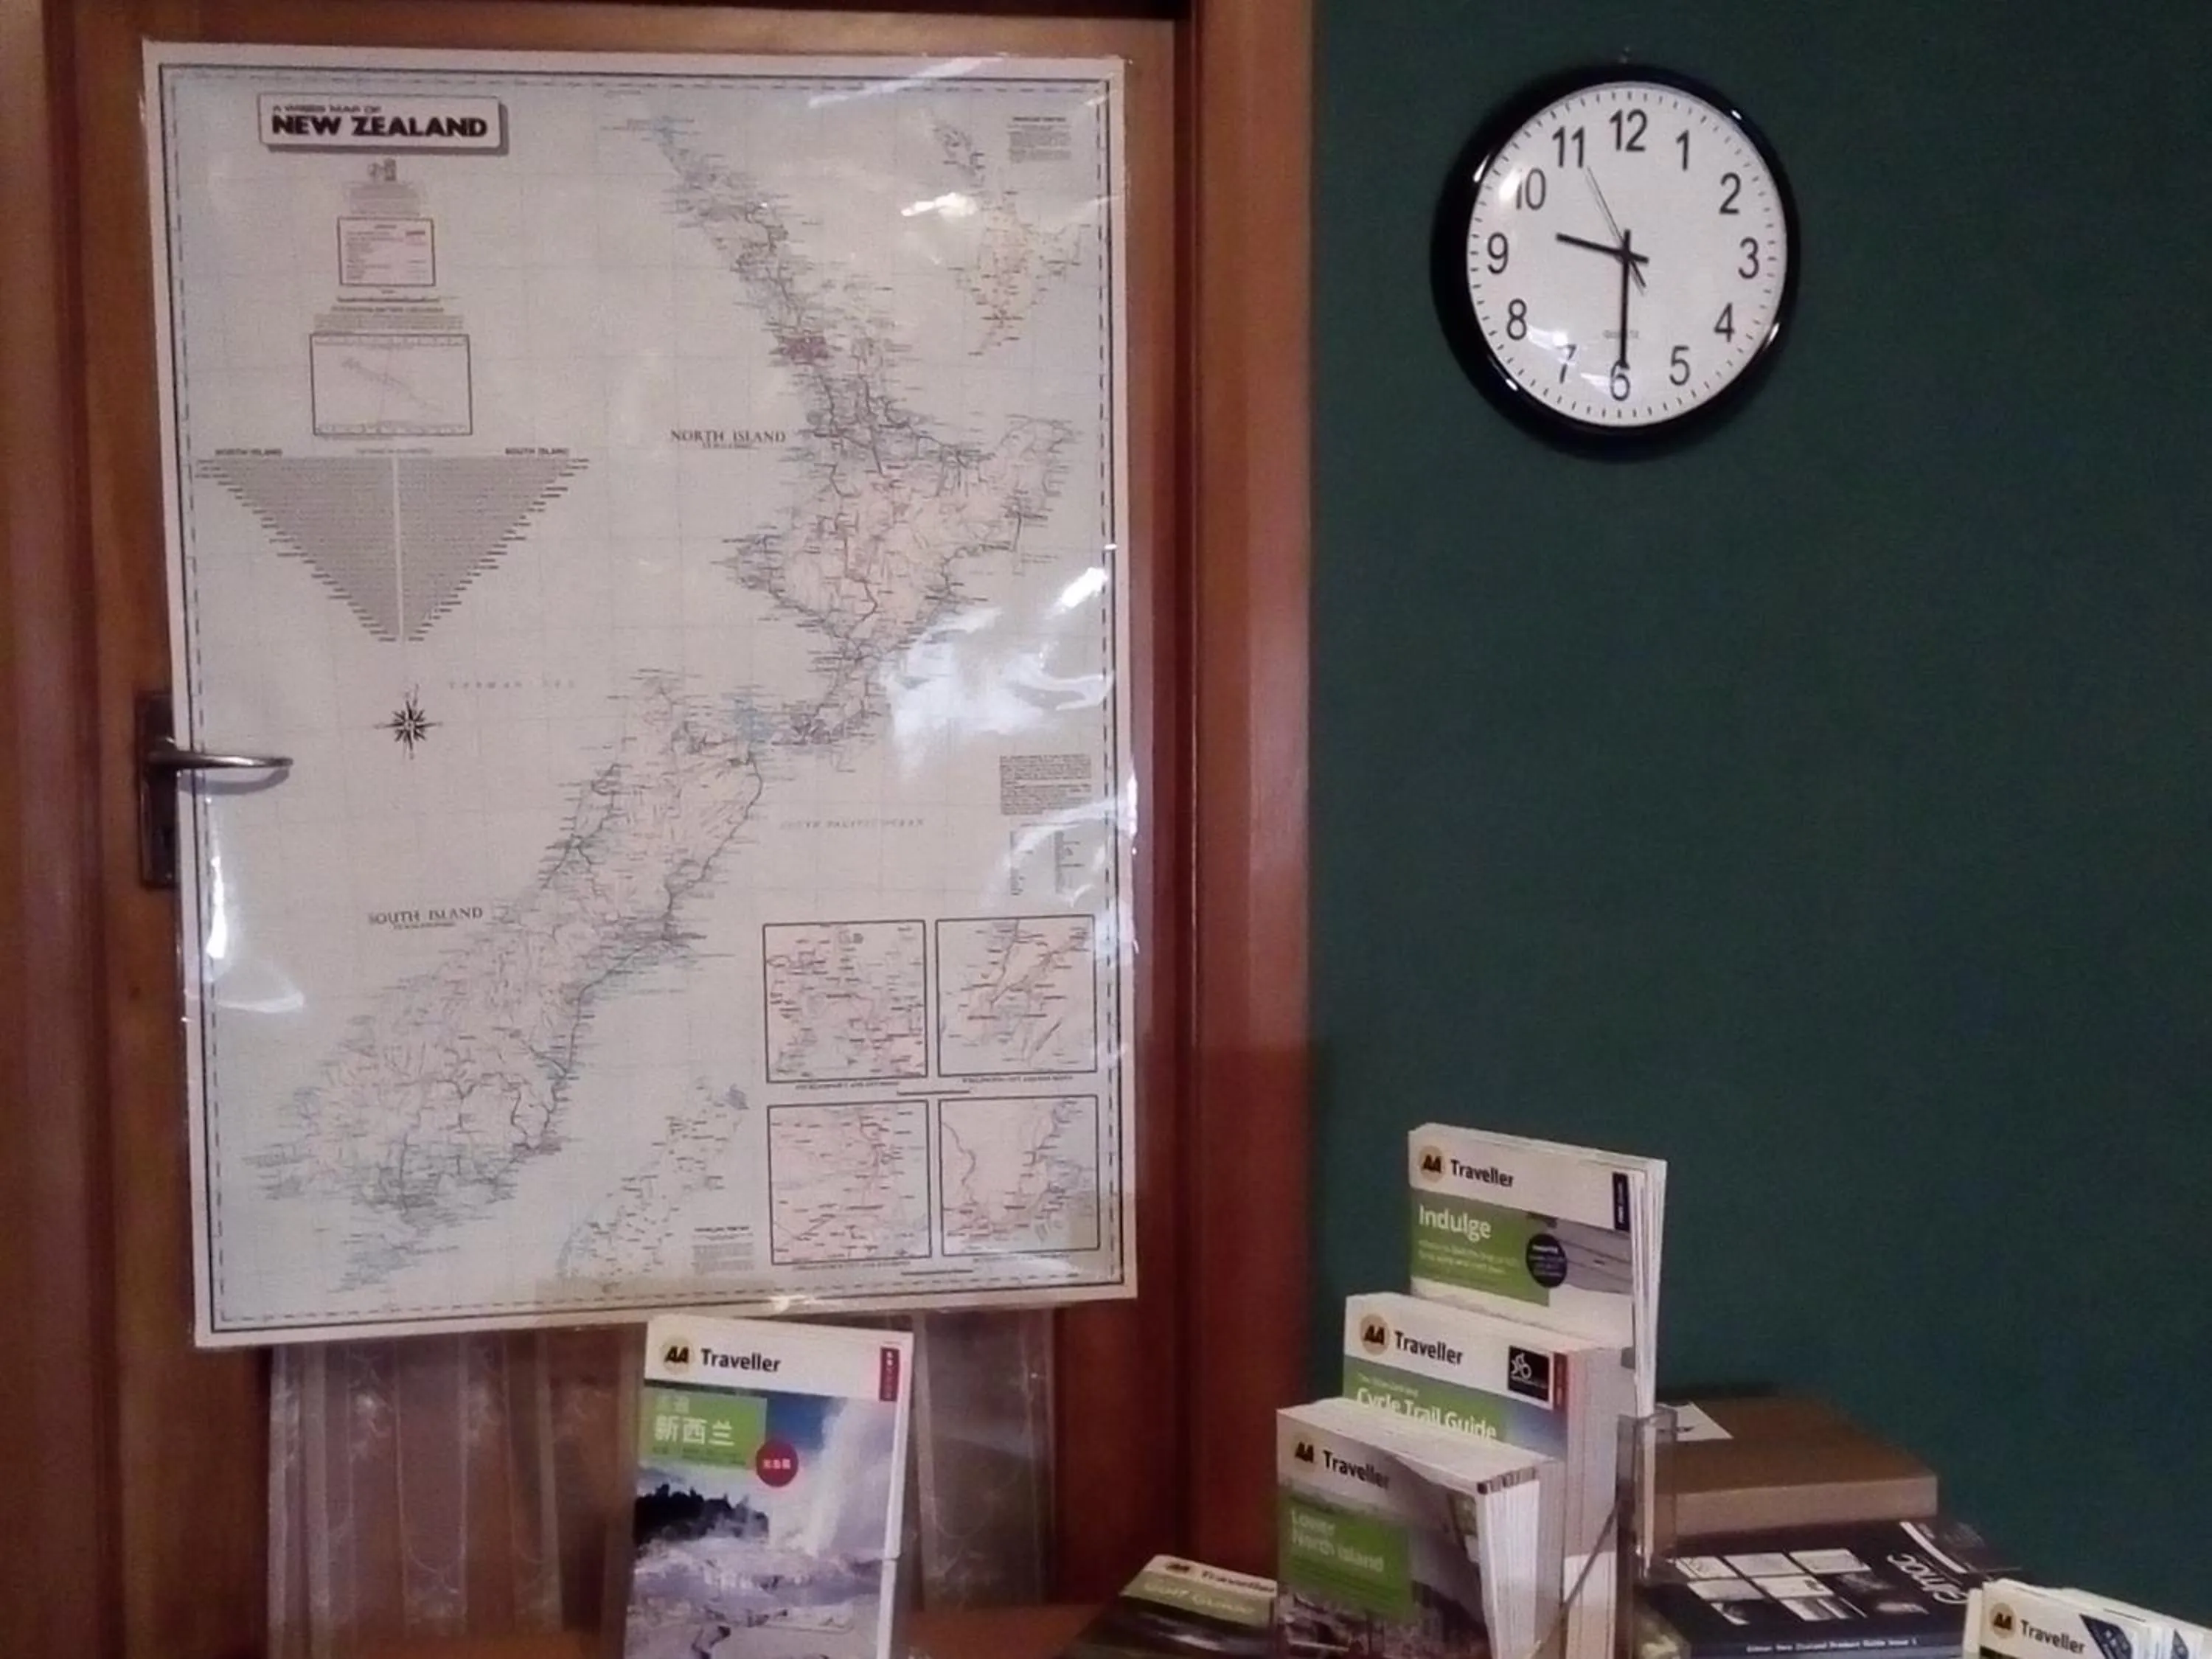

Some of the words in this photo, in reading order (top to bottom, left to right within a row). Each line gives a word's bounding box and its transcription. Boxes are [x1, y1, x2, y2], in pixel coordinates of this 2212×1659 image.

[272, 115, 341, 135] NEW
[352, 116, 487, 137] ZEALAND
[1609, 108, 1648, 152] 12
[1552, 126, 1585, 168] 11
[1676, 130, 1690, 171] 1
[1515, 168, 1546, 210] 10
[1719, 173, 1742, 215] 2
[1487, 232, 1509, 274] 9
[1738, 237, 1760, 279] 3
[1506, 299, 1527, 340] 8
[1714, 303, 1734, 342] 4
[1557, 344, 1577, 383] 7
[1610, 360, 1630, 400] 6
[1670, 346, 1690, 385] 5
[671, 429, 724, 442] NORTH
[733, 430, 786, 442] ISLAND
[369, 909, 420, 925] SOUTH
[429, 906, 483, 920] ISLAND
[1421, 1154, 1441, 1173] AA
[1450, 1158, 1514, 1187] Traveller
[1419, 1204, 1492, 1242] Indulge
[665, 1346, 689, 1363] AA
[700, 1348, 782, 1372] Traveller
[1363, 1324, 1385, 1346] AA
[1394, 1330, 1464, 1366] Traveller
[654, 1414, 735, 1447] 新西兰
[1357, 1388, 1401, 1411] Cycle
[1402, 1399, 1441, 1427] Trail
[1444, 1411, 1497, 1441] Guide
[1322, 1450, 1390, 1489] Traveller
[1292, 1509, 1335, 1536] Lower
[1292, 1533, 1335, 1556] North
[1337, 1545, 1384, 1572] Island
[1993, 1612, 2012, 1630] AA
[2020, 1619, 2085, 1654] Traveller
